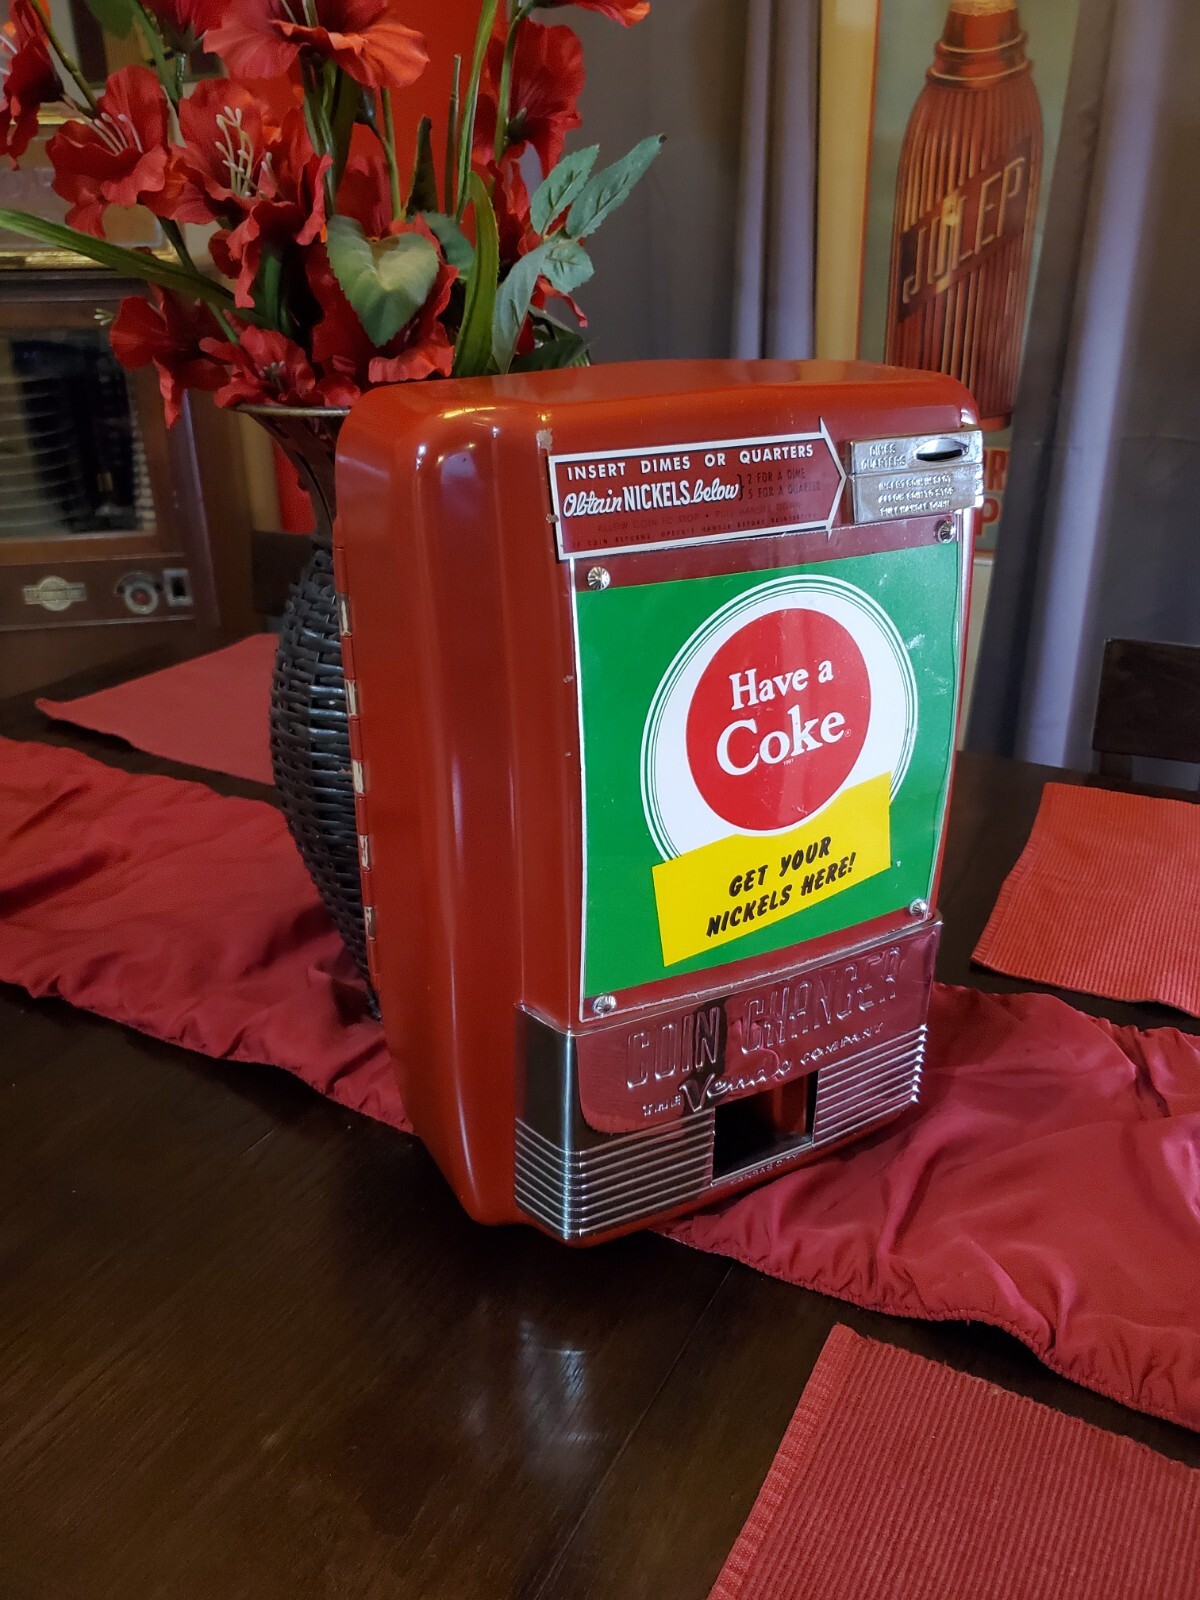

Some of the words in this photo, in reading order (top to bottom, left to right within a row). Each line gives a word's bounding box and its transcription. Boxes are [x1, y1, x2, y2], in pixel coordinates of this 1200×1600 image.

[903, 157, 1025, 303] JULEP
[567, 462, 626, 480] INSERT
[641, 456, 691, 474] DIMES
[704, 453, 726, 467] OR
[739, 444, 814, 464] QUARTERS
[869, 443, 896, 457] DIMES
[748, 488, 753, 499] 5
[758, 486, 774, 498] FOR
[778, 485, 784, 496] A
[757, 472, 773, 483] FOR
[777, 471, 783, 481] A
[787, 468, 806, 480] DIME
[563, 489, 622, 518] Obtain
[622, 480, 691, 511] NICKELS
[691, 478, 740, 503] below
[729, 668, 809, 710] Have
[817, 660, 834, 683] a
[728, 864, 769, 897] GET
[779, 836, 831, 877] YOUR
[706, 884, 793, 937] NICKELS
[800, 851, 857, 896] HERE!
[626, 1006, 721, 1089] COIN
[740, 947, 901, 1055] CHANGER
[800, 1022, 883, 1065] COMPANY
